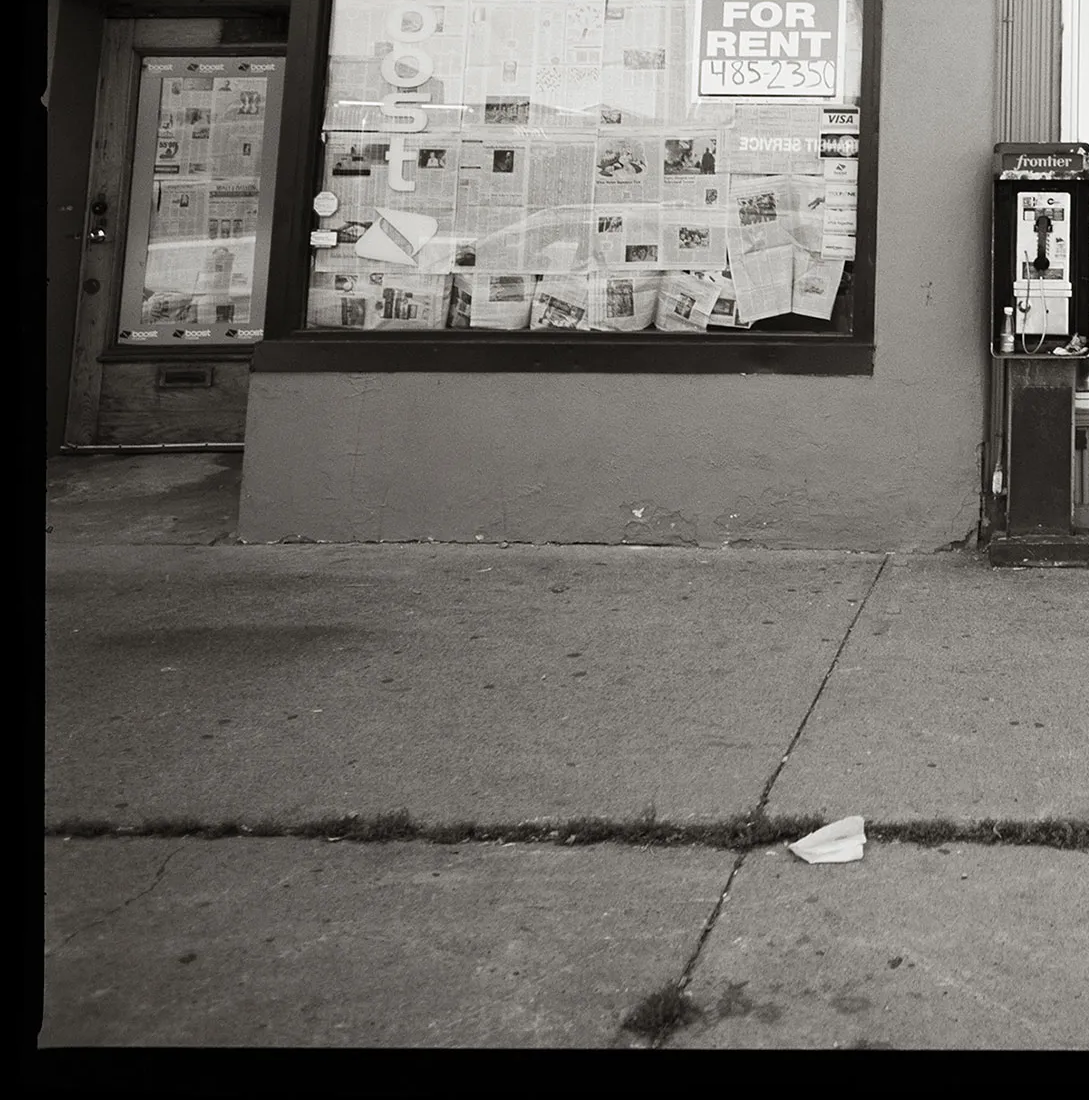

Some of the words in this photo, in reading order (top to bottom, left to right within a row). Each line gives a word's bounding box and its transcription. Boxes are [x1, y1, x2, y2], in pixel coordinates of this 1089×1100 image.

[722, 1, 816, 28] FOR
[706, 30, 832, 58] RENT
[710, 59, 836, 90] 485-2350
[827, 114, 854, 124] VISA
[1016, 154, 1073, 171] frontier
